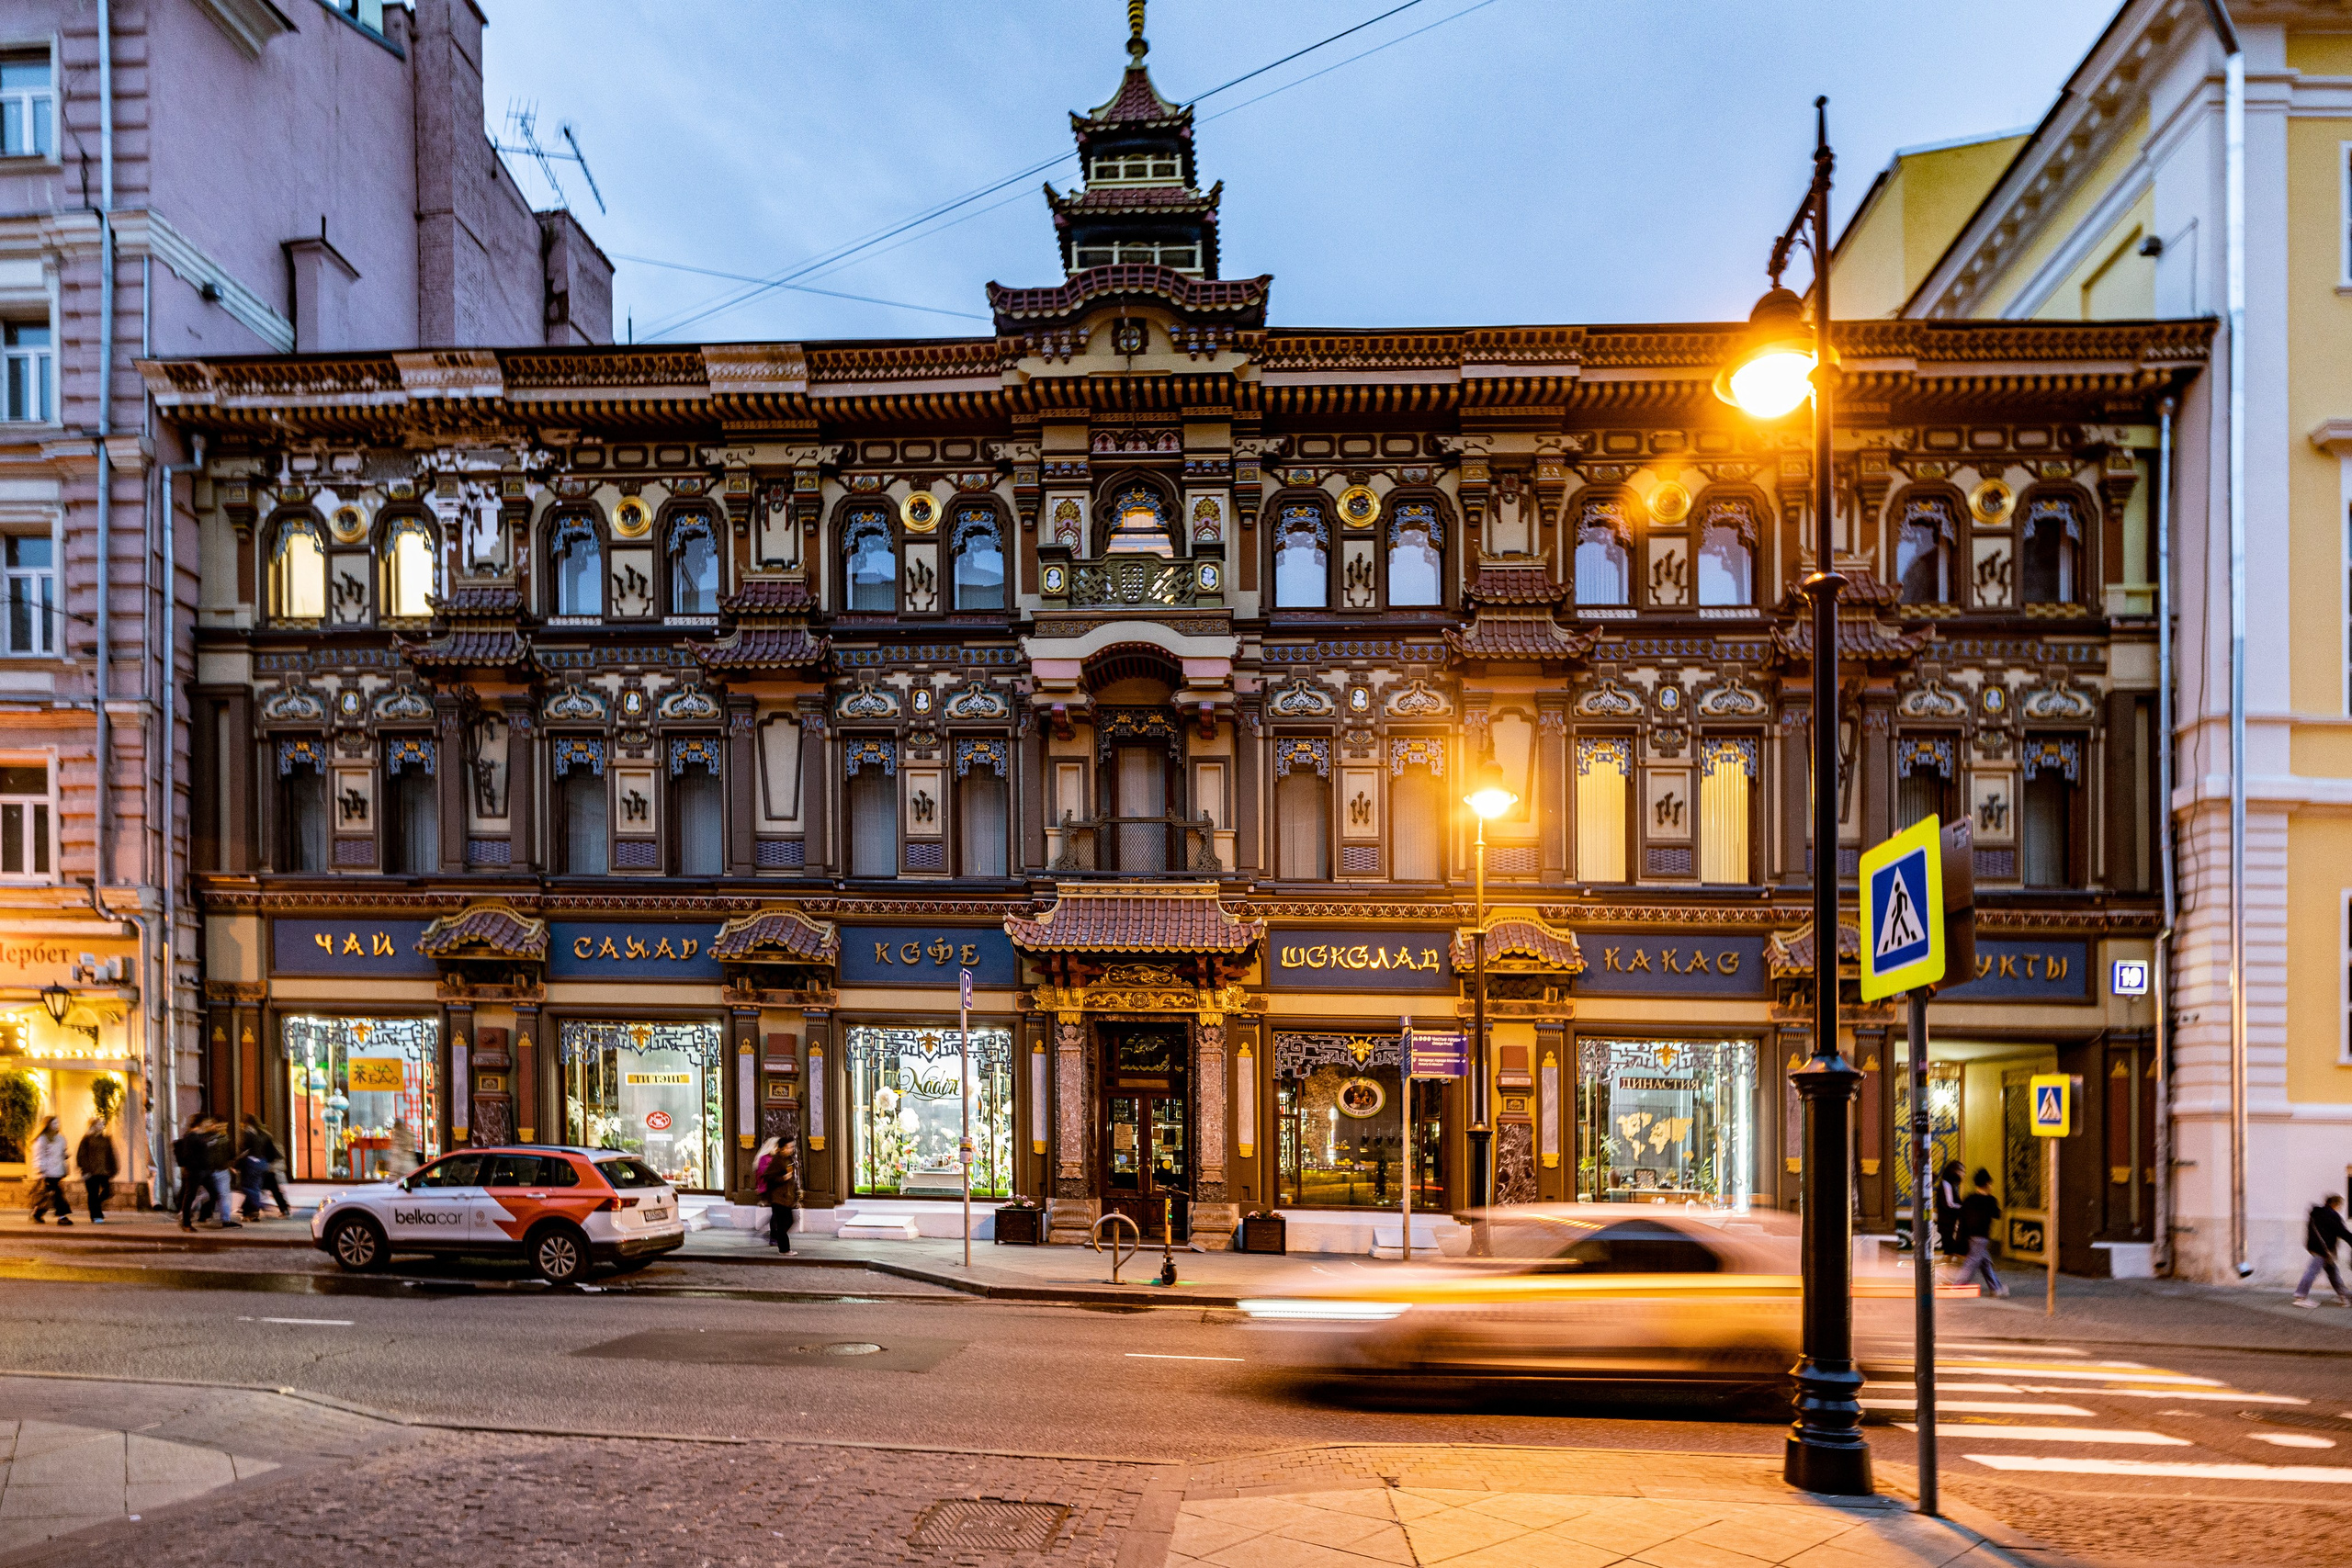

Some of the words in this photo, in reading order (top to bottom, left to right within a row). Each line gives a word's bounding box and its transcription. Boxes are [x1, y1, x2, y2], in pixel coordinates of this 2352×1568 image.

[0, 942, 70, 970] ербет
[314, 931, 395, 956] ЧАЙ
[573, 934, 698, 960] САХАР
[875, 937, 980, 965] КОФЕ
[1281, 944, 1441, 974] ШОКОЛАД
[1603, 946, 1741, 975] КАКАО
[1975, 954, 2068, 980] УКТЫ
[634, 1075, 650, 1083] ТИ
[652, 1074, 685, 1083] ТЭНГ
[1621, 1077, 1700, 1090] ДИНАСТИЯ
[394, 1208, 463, 1224] belkacar
